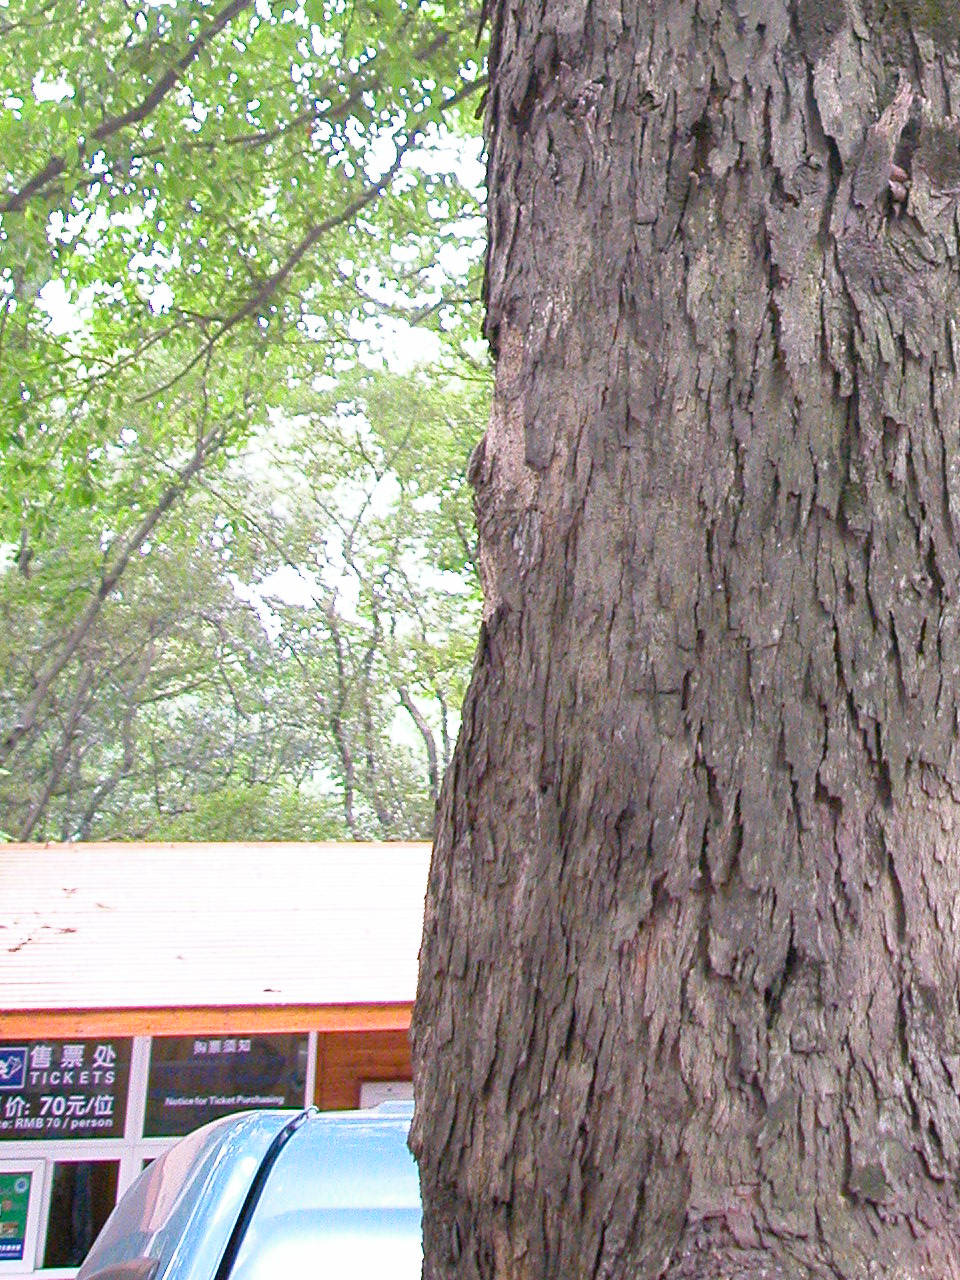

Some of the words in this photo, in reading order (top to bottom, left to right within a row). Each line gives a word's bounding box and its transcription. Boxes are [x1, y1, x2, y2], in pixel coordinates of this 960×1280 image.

[30, 1045, 116, 1068] 售票处
[29, 1071, 116, 1085] TICKETS
[164, 1096, 194, 1105] Notice
[209, 1095, 236, 1105] Ticket
[15, 1118, 44, 1129] RMB
[46, 1118, 60, 1128] 70
[70, 1120, 114, 1130] person
